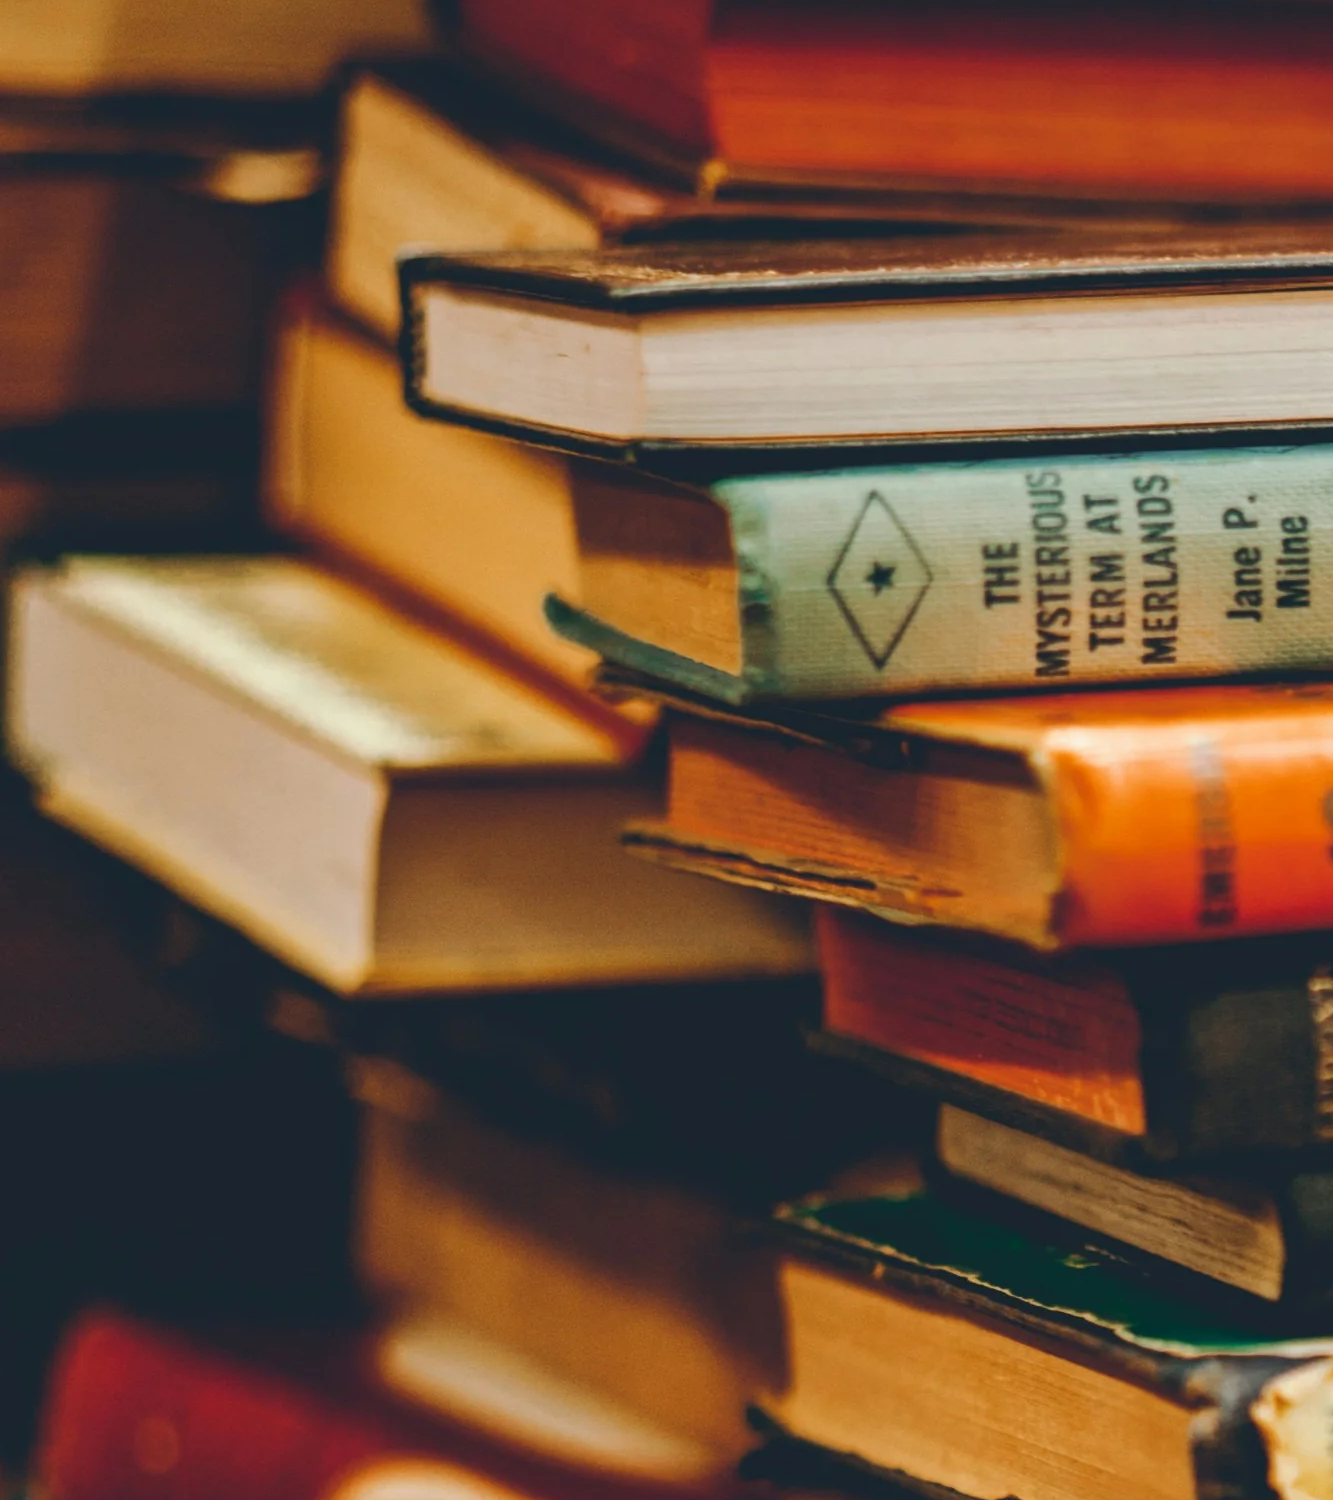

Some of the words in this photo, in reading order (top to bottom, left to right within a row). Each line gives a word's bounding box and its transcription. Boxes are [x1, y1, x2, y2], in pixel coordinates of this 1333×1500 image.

[1083, 493, 1123, 535] AT
[1222, 493, 1259, 529] P.
[982, 541, 1021, 609] THE
[1025, 470, 1072, 678] MYSTERIOUS
[1087, 553, 1126, 652] TERM
[1132, 473, 1180, 665] MERLANDS
[1226, 545, 1263, 623] Jane
[1275, 514, 1311, 609] Milne
